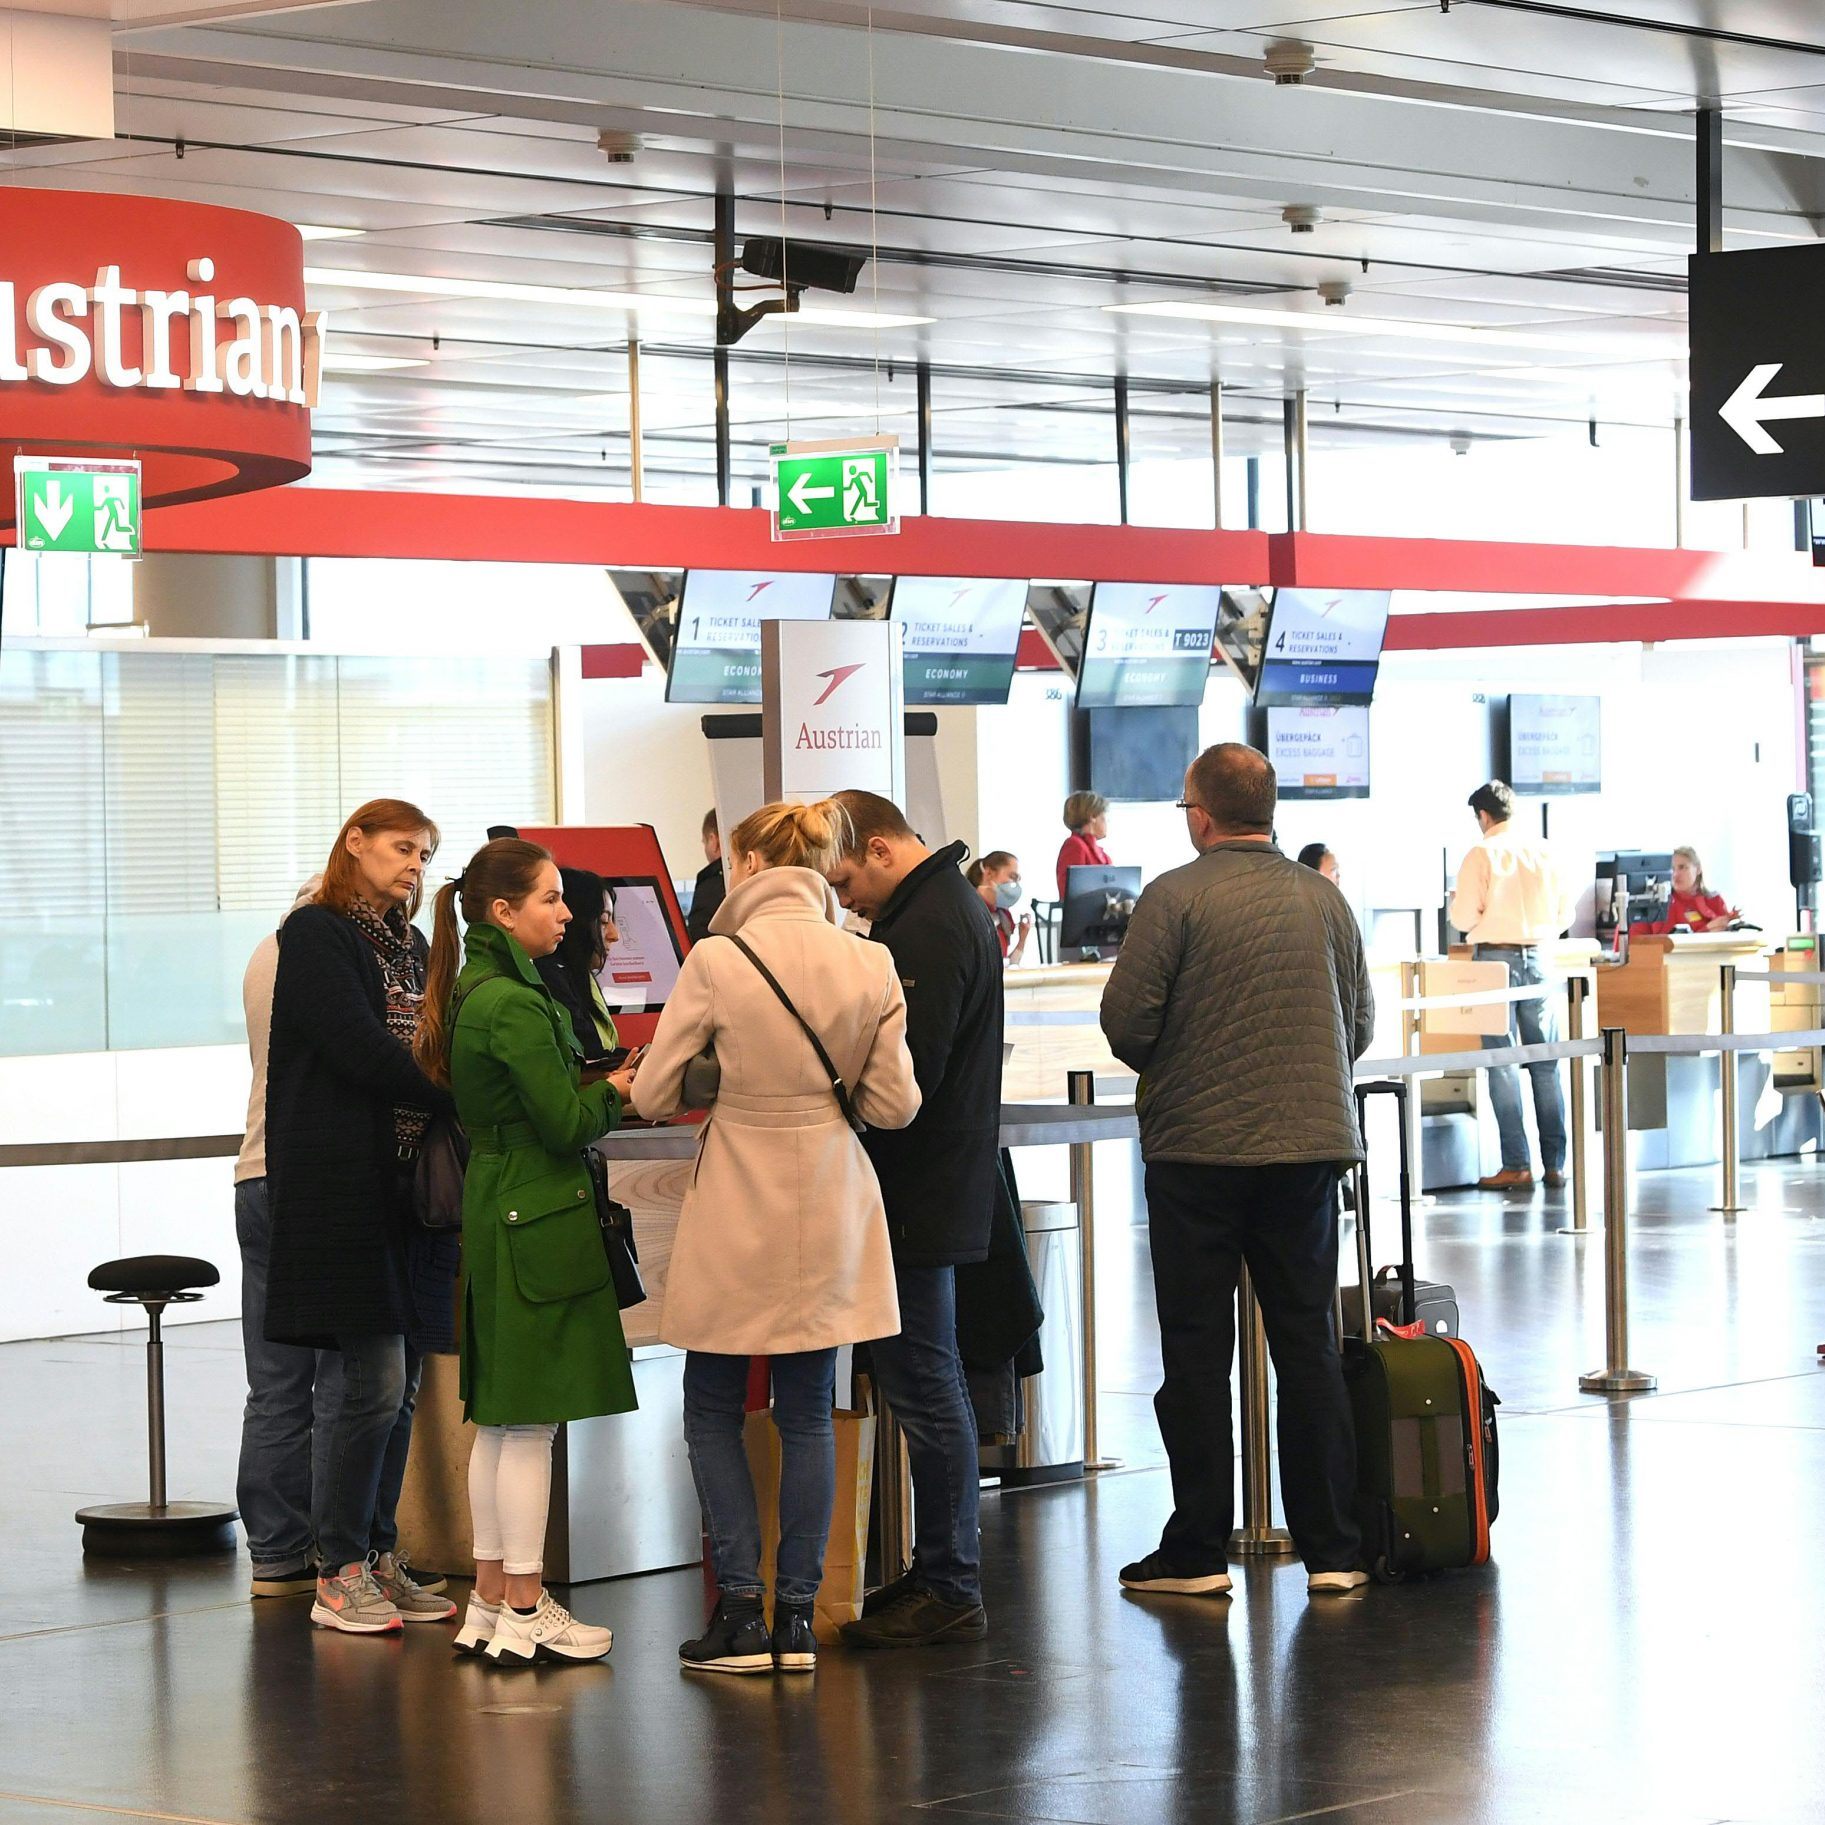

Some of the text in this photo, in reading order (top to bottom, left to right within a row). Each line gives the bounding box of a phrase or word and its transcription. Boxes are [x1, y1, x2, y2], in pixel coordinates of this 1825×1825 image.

[709, 617, 761, 628] TICKET SALE
[914, 622, 940, 633] TICKET
[943, 623, 966, 633] SALES
[692, 616, 700, 641] 1
[706, 631, 760, 643] RESERVATIO
[911, 636, 969, 647] RESERVATIONS
[1174, 633, 1210, 647] T 9023
[1275, 630, 1286, 653] 4
[1291, 631, 1314, 641] TICKET
[1316, 632, 1337, 642] SALES
[1288, 644, 1338, 655] RESERVATIONS
[723, 666, 761, 677] ECONO
[925, 669, 969, 680] ECONOMY
[1299, 673, 1338, 685] BUSINESS
[795, 722, 882, 749] Austrian
